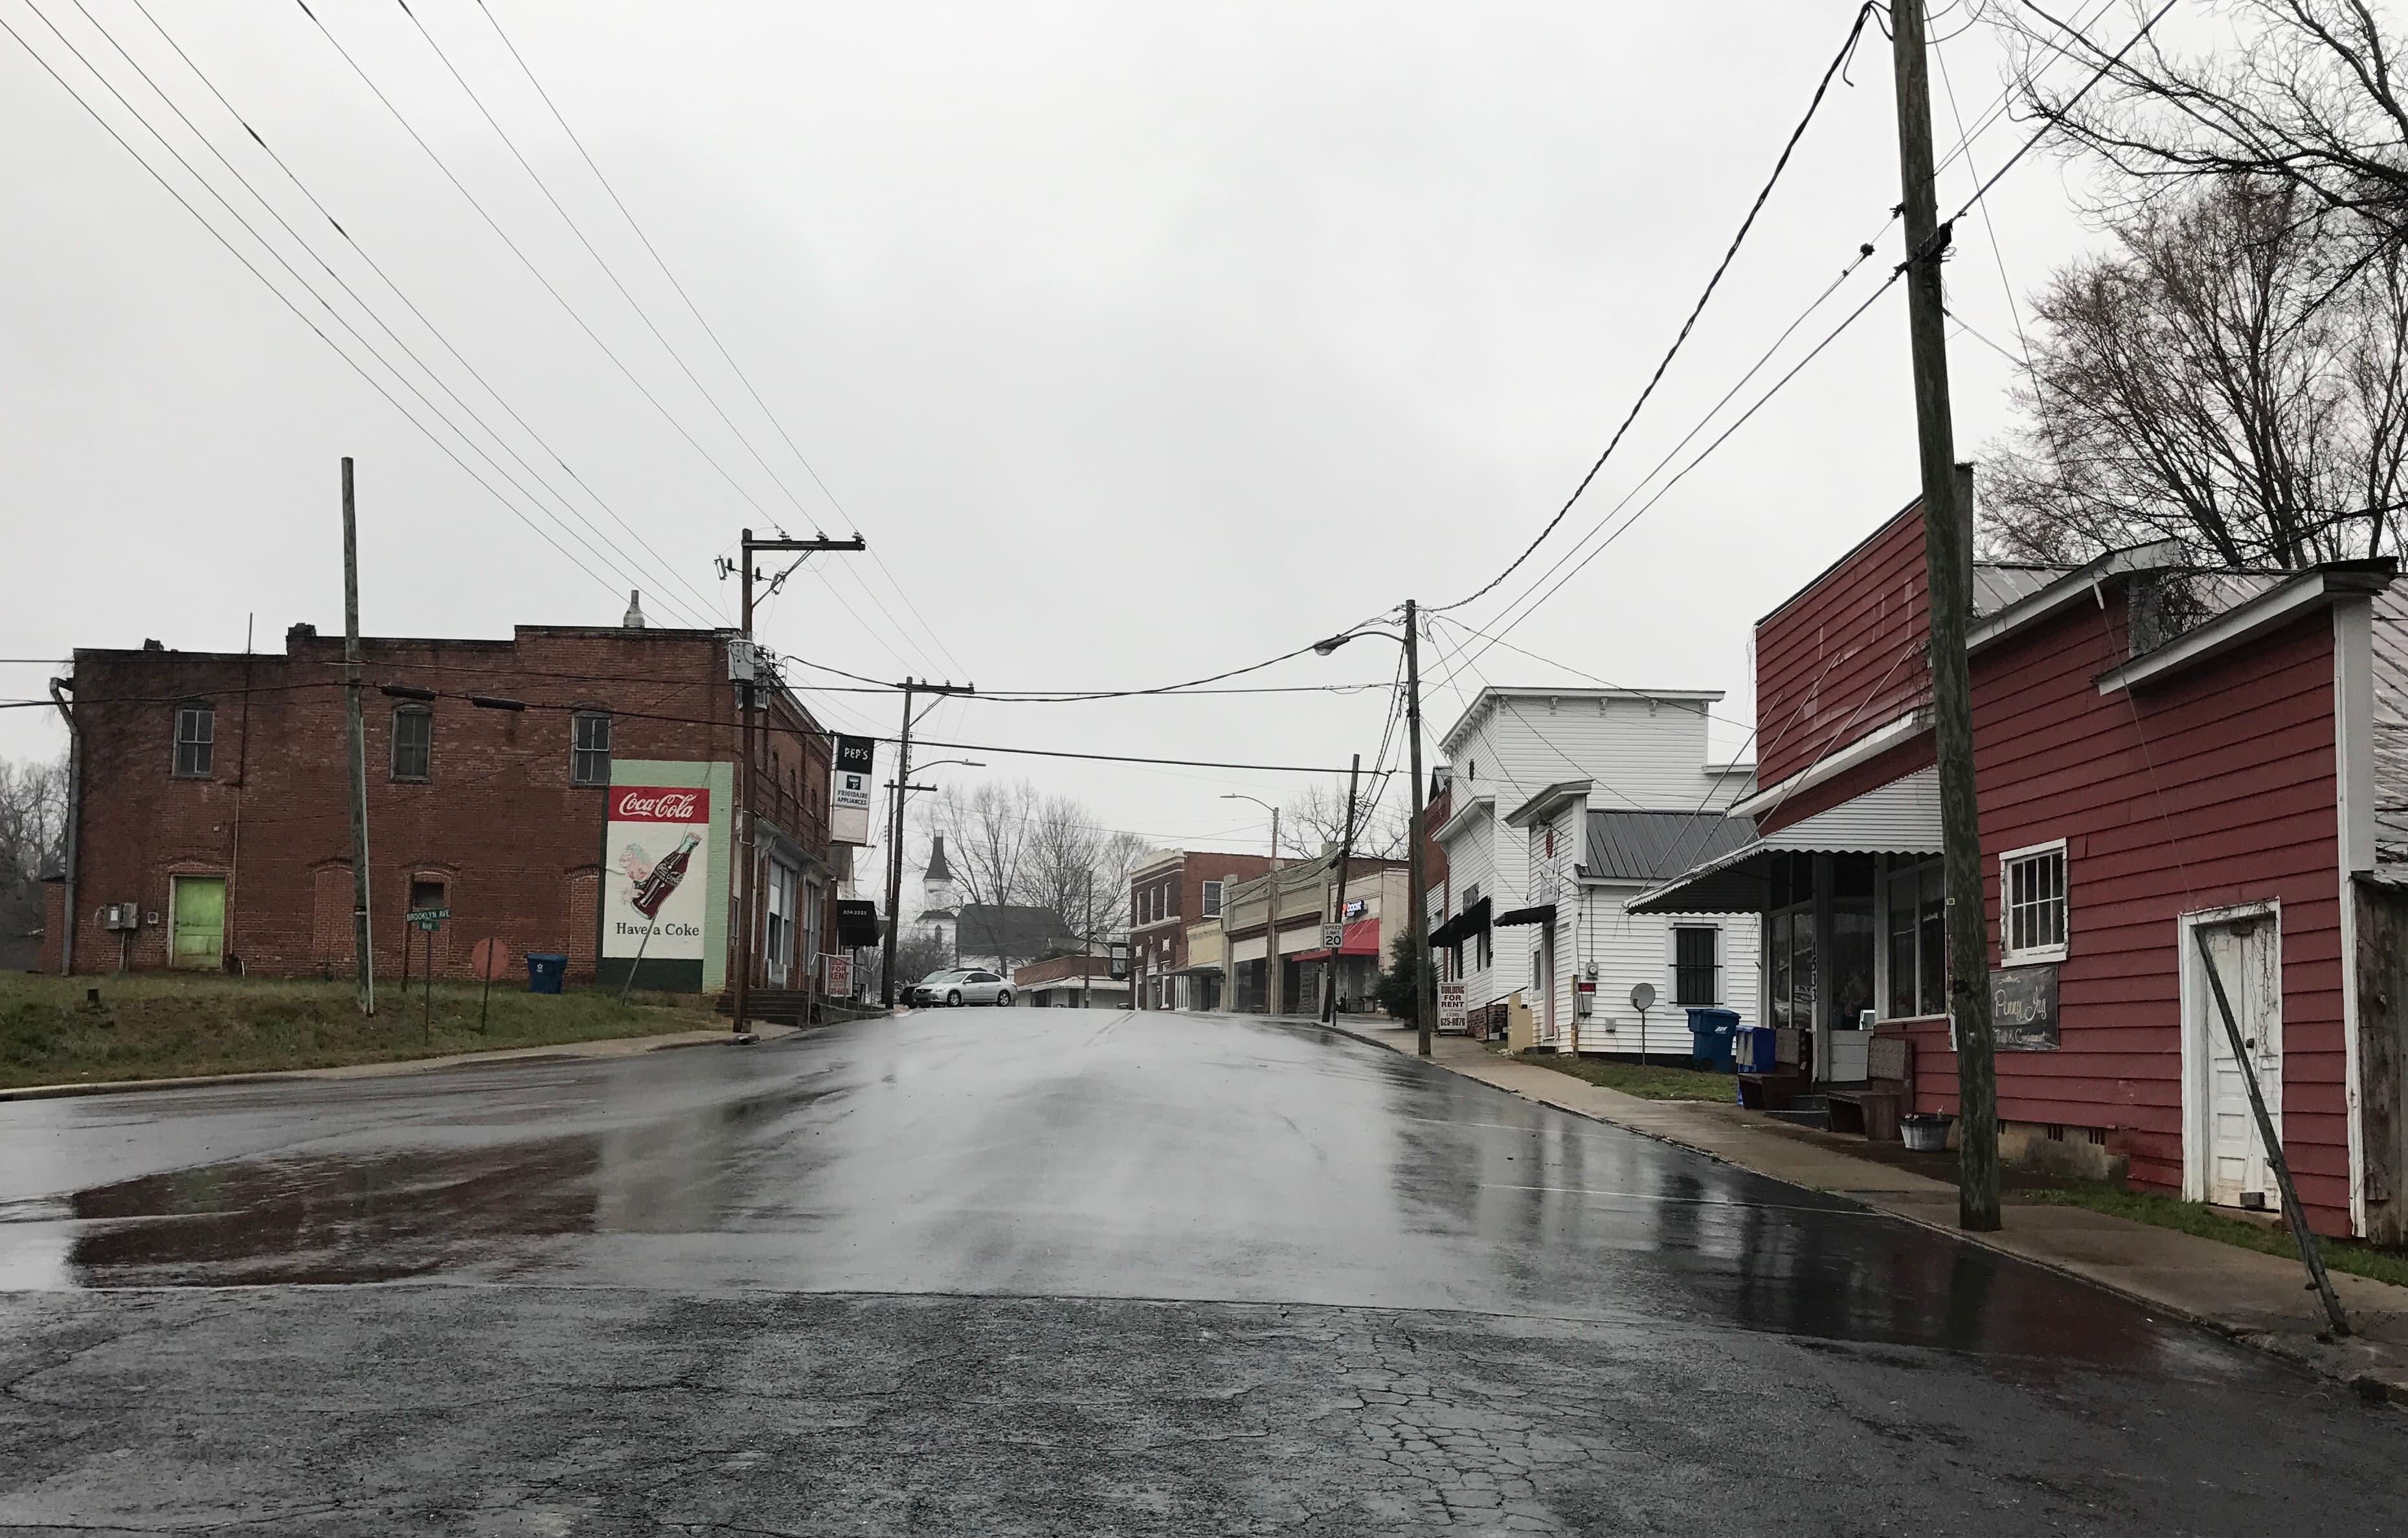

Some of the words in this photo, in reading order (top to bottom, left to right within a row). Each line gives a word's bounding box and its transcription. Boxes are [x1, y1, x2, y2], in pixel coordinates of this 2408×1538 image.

[844, 747, 869, 760] PEP'S
[837, 789, 868, 799] FRIGIDAIRE
[837, 797, 867, 806] APPLIANCES
[1347, 900, 1362, 912] boost
[406, 911, 437, 922] BROOKLYN
[439, 909, 451, 918] AVE
[616, 922, 648, 934] Have
[653, 927, 661, 935] a
[665, 923, 699, 936] Coke
[1325, 936, 1341, 945] 20
